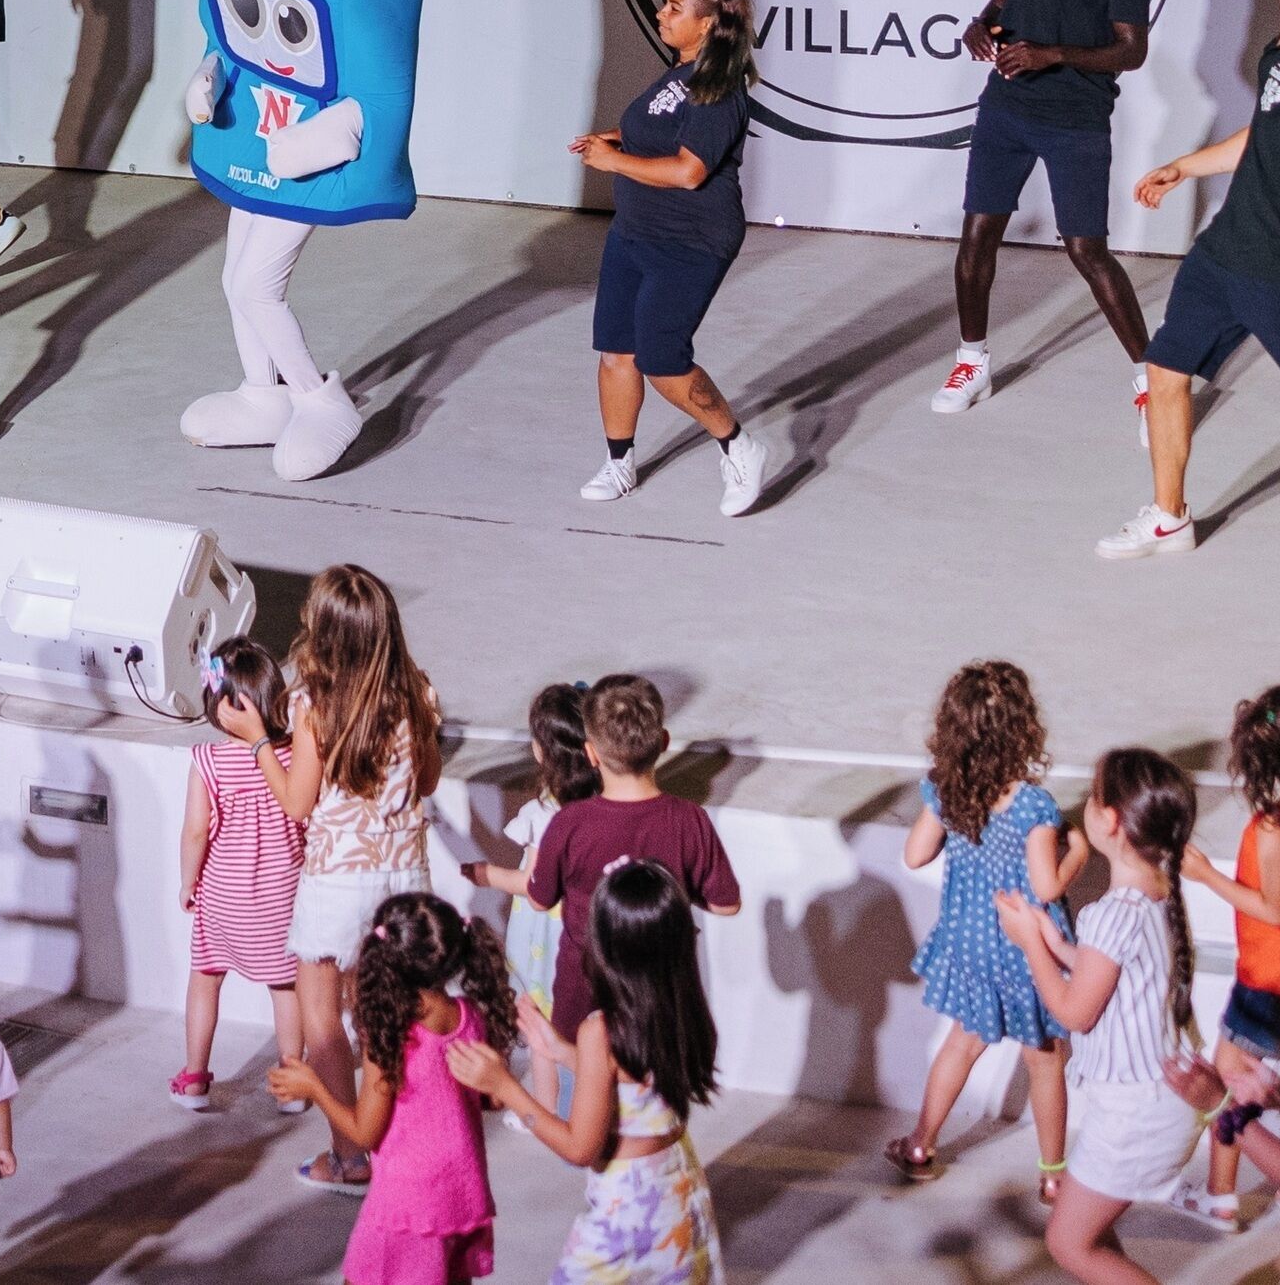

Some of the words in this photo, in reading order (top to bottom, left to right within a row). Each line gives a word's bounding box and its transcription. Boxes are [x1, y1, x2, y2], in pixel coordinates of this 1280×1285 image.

[753, 6, 995, 62] VILLAG
[258, 89, 291, 136] N
[227, 164, 281, 191] NICOLINO
